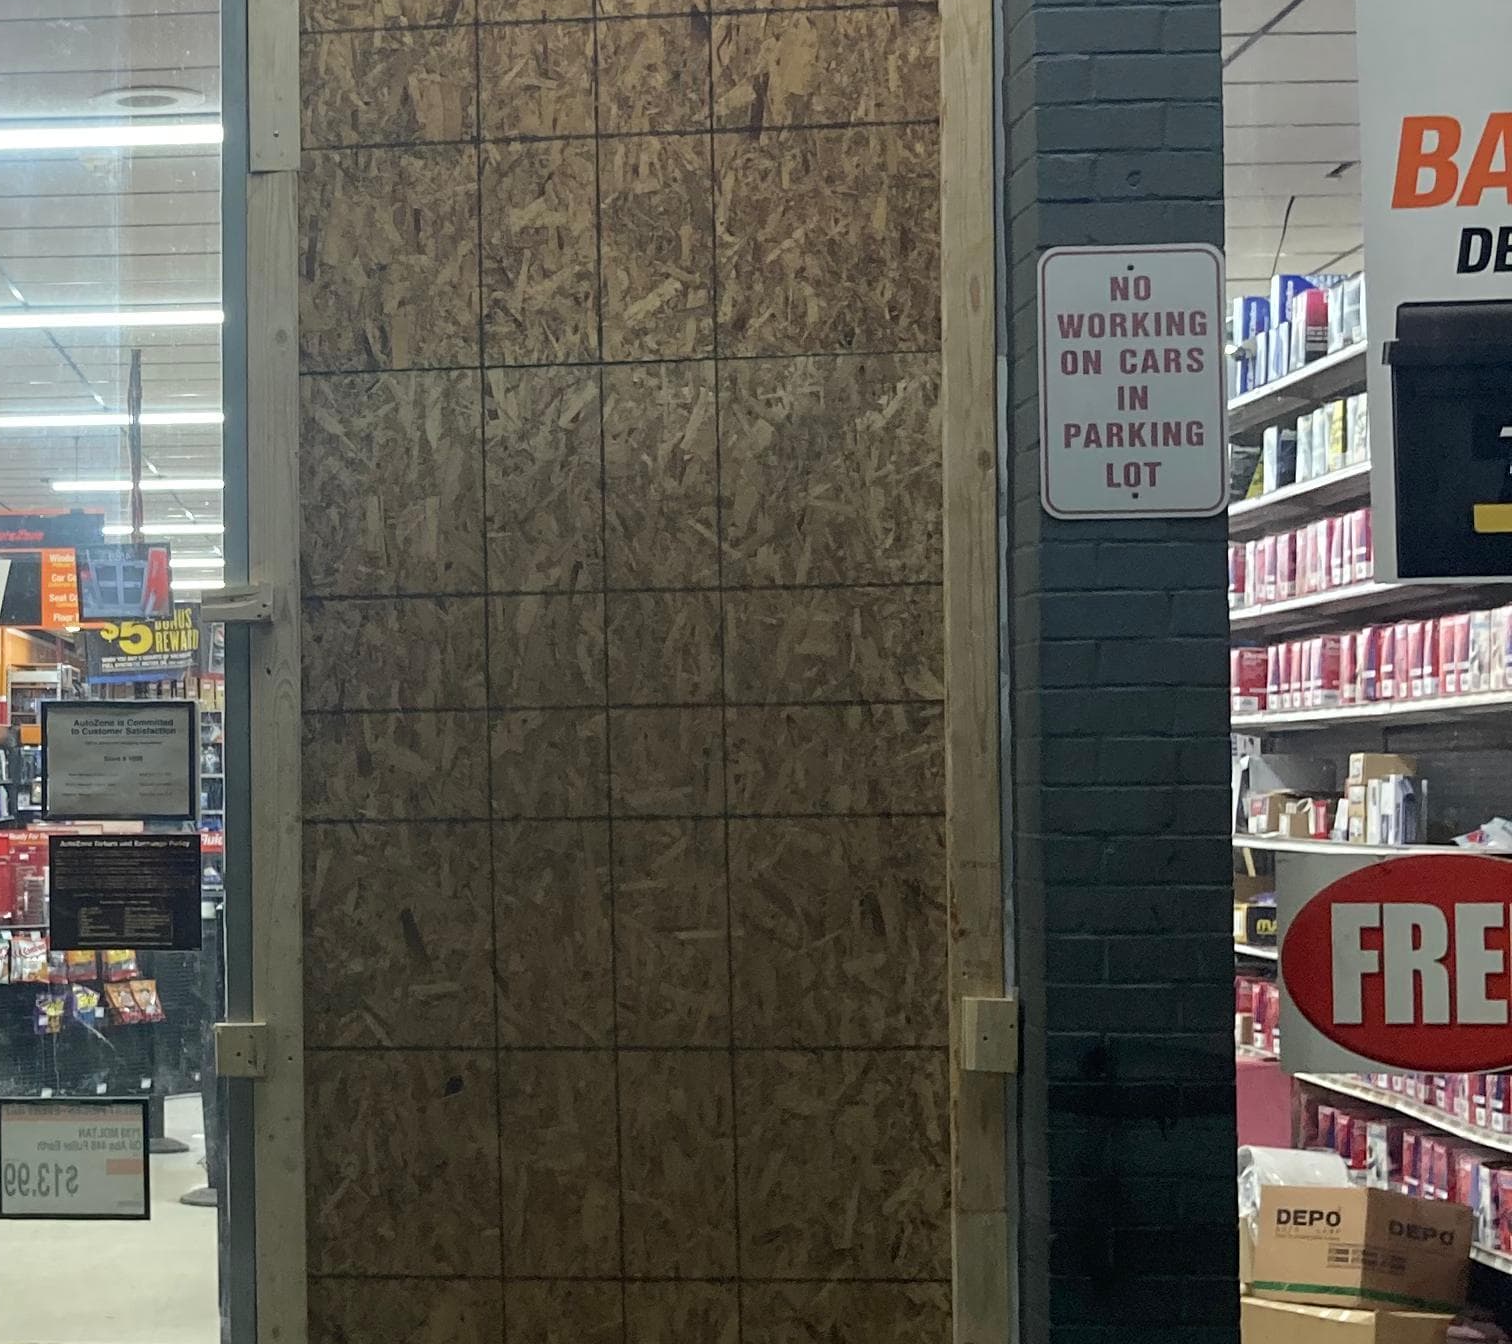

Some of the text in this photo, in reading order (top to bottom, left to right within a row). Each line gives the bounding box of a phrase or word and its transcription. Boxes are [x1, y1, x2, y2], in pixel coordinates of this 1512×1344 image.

[1110, 276, 1152, 301] NO
[1057, 310, 1208, 339] WORKING
[1061, 347, 1205, 375] ON CARS
[1117, 385, 1148, 411] IN
[1063, 420, 1205, 448] PARKING
[1106, 461, 1162, 488] LOT
[155, 629, 199, 653] REWARD
[1331, 902, 1512, 1025] FRE
[1276, 1208, 1342, 1227] DEPO
[1388, 1219, 1456, 1247] DEPO
